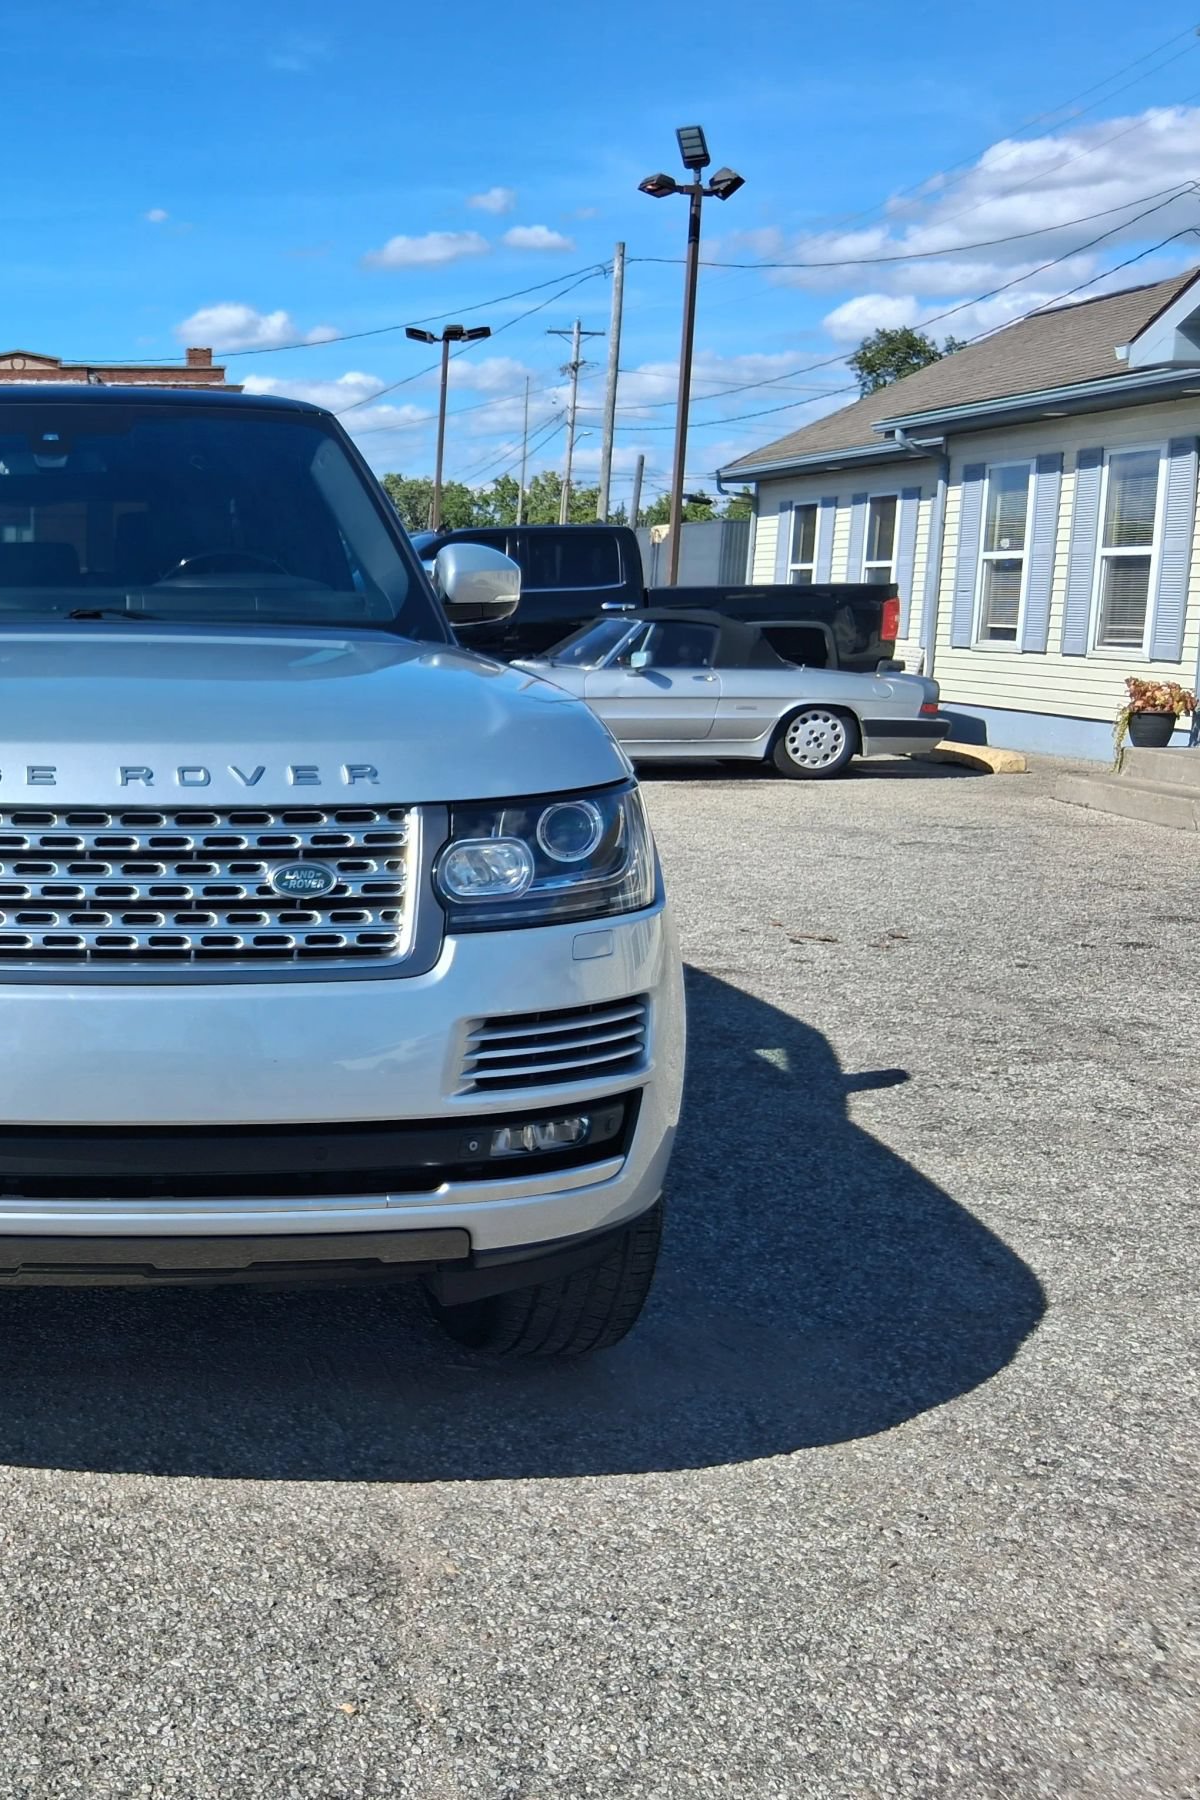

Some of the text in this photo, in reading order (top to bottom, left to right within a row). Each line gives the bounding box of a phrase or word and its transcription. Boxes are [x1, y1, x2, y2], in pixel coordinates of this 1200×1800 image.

[119, 763, 380, 787] ROVER
[285, 870, 315, 879] LAND
[289, 879, 325, 889] ROVER
